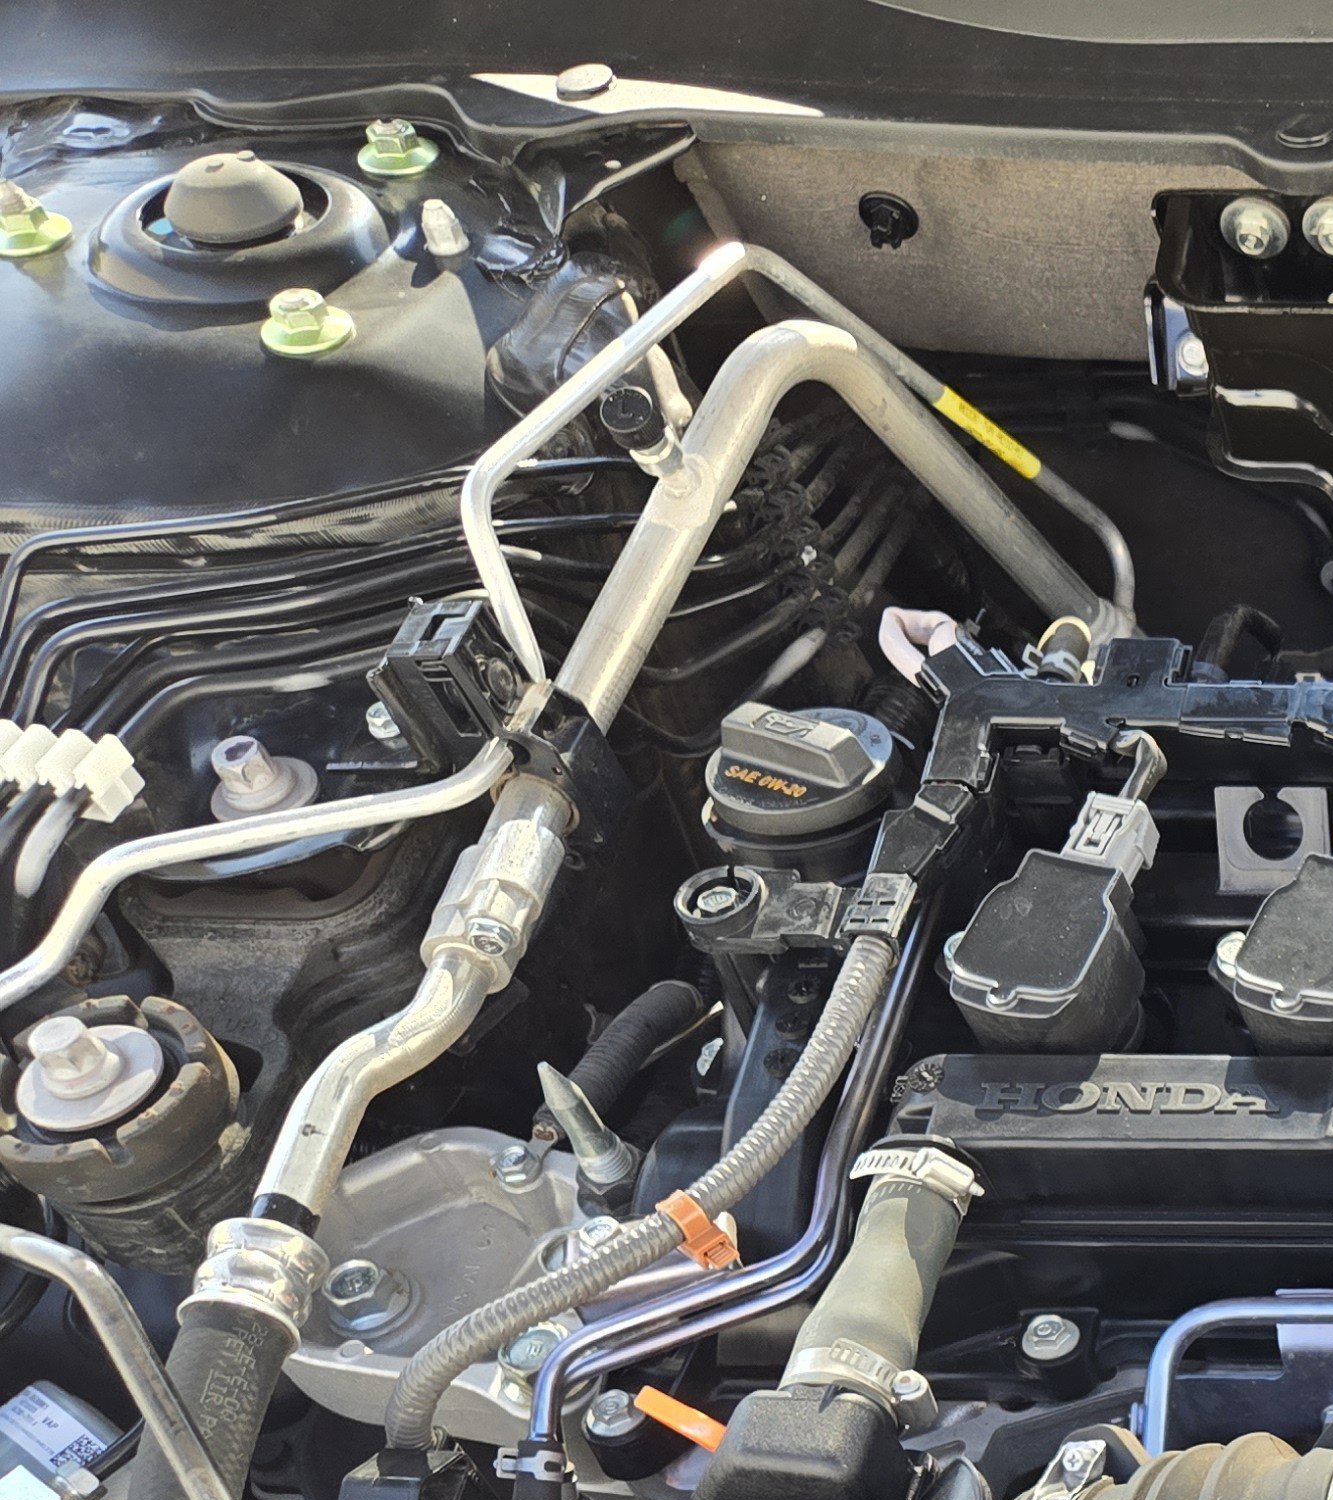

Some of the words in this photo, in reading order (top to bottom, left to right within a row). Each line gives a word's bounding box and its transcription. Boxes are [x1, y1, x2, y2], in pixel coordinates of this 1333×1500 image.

[725, 765, 761, 784] SAE
[757, 775, 808, 798] 0W-20
[974, 1080, 1281, 1116] HONDA
